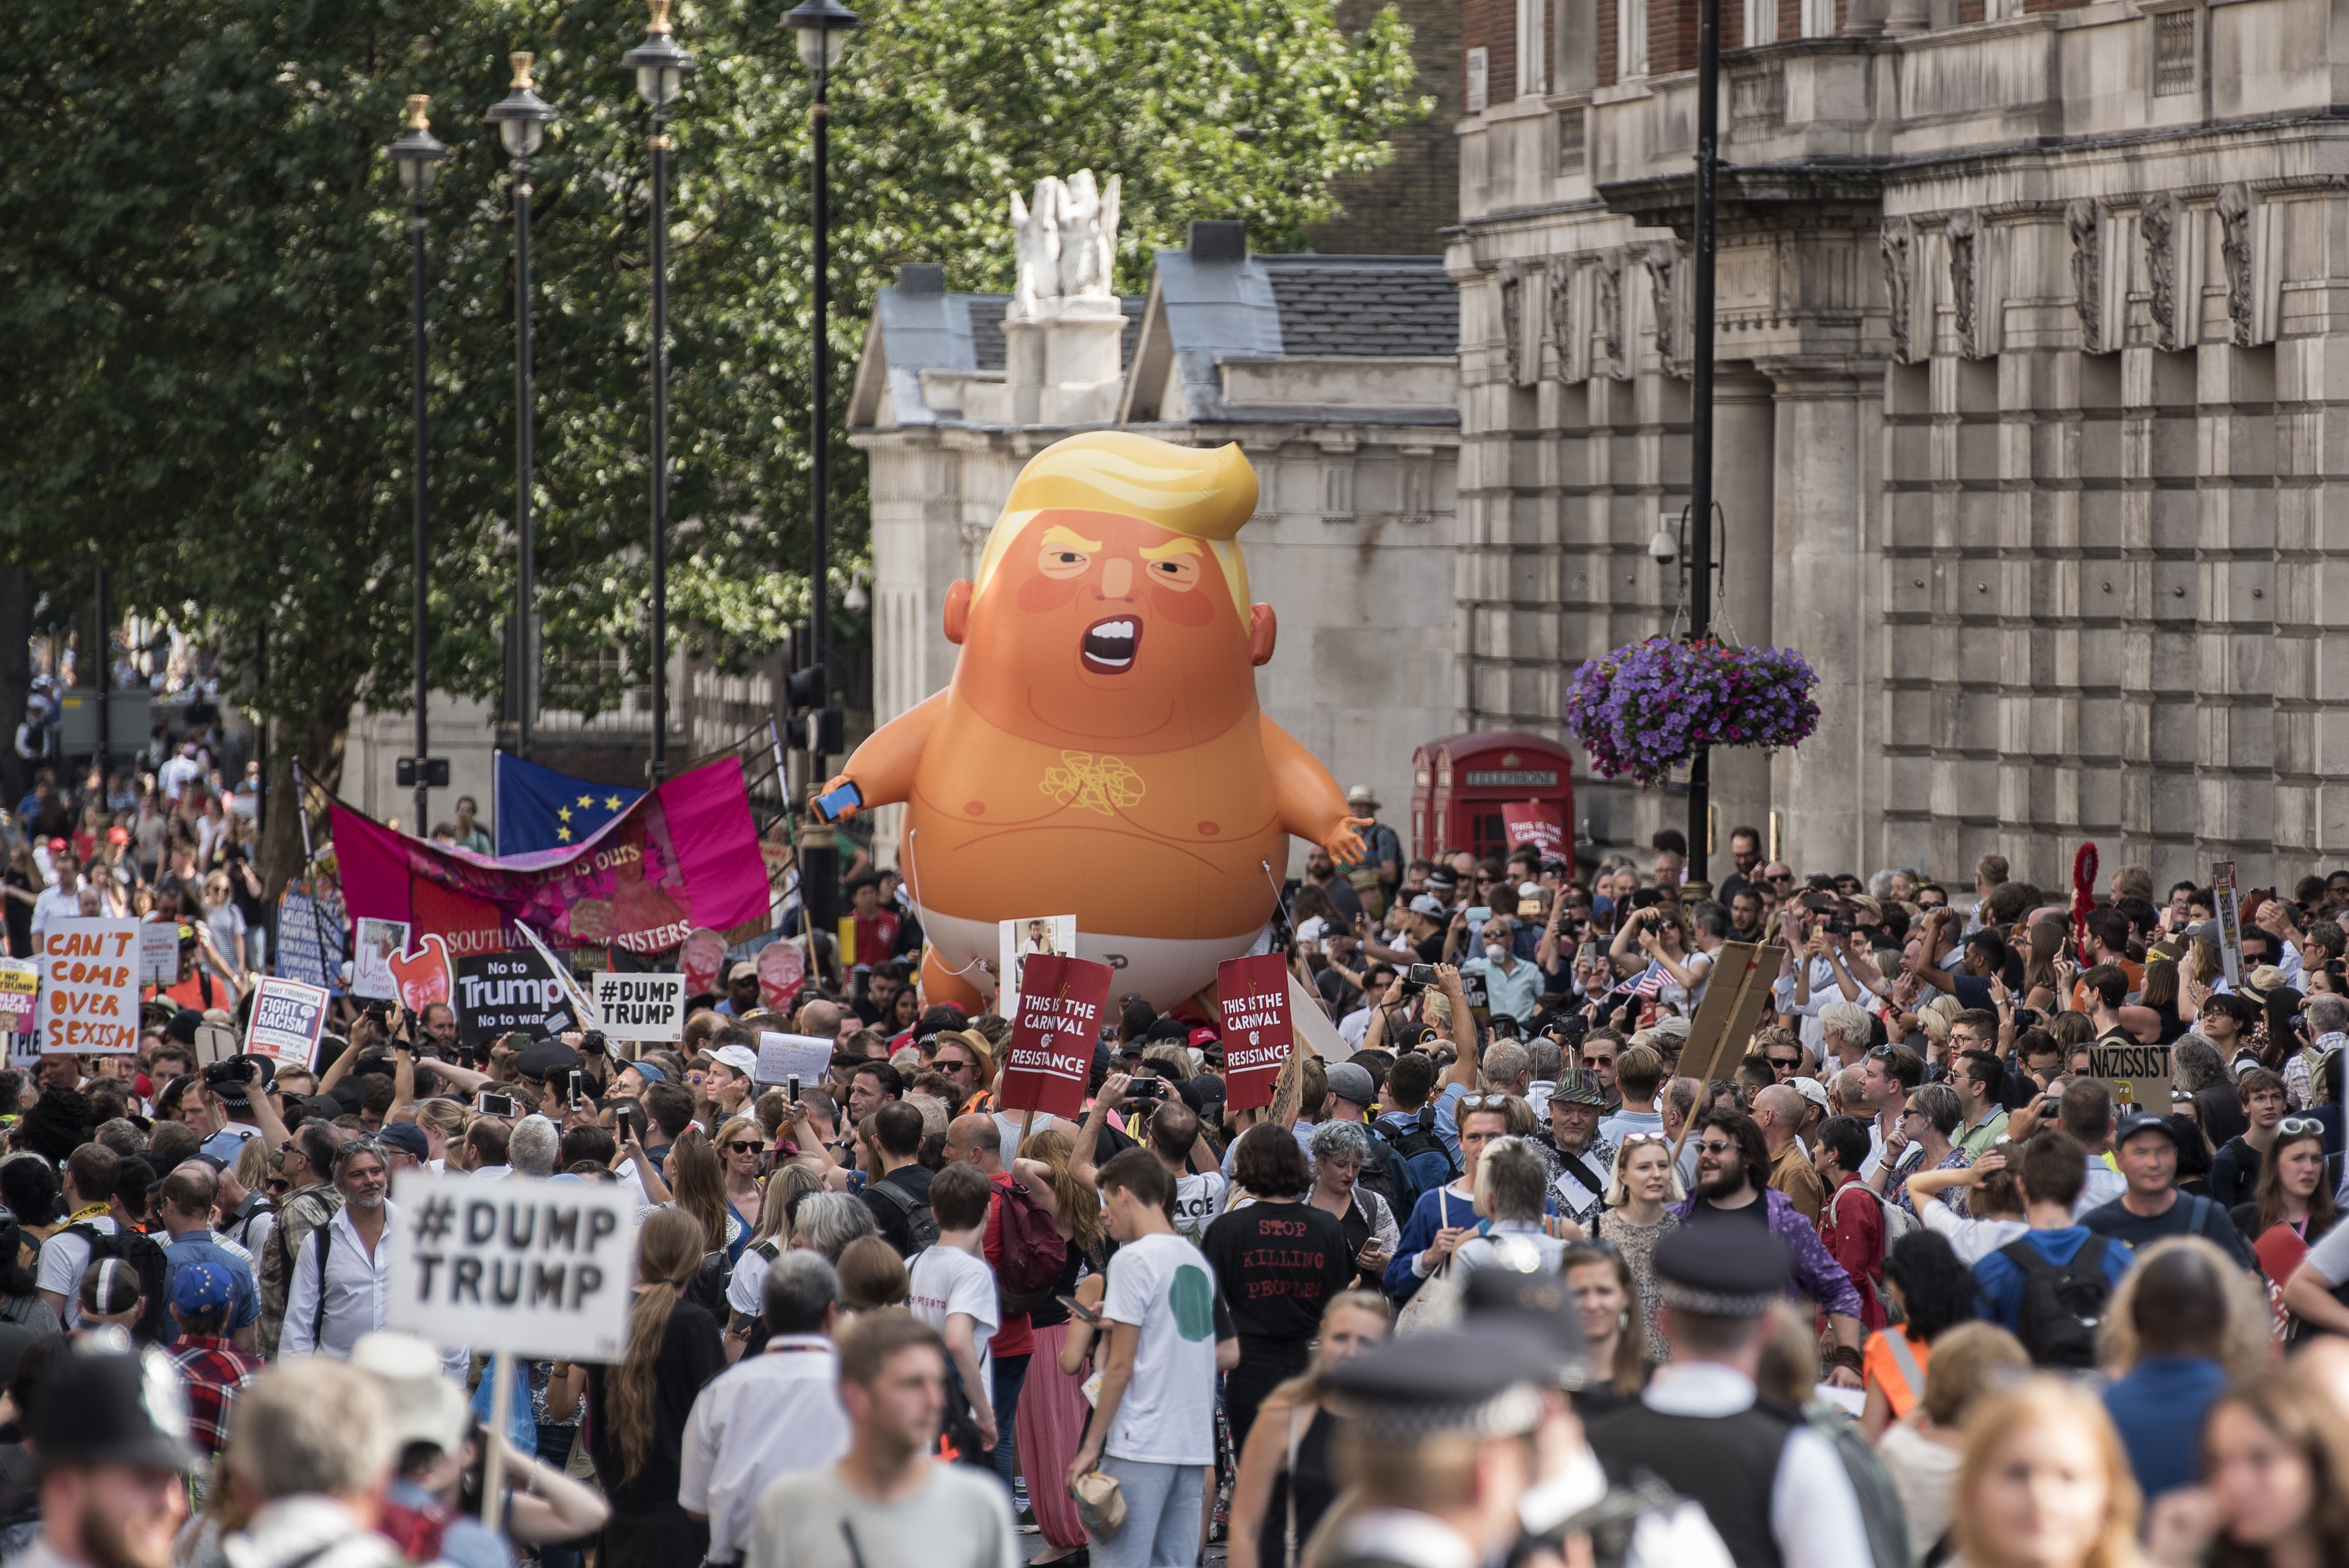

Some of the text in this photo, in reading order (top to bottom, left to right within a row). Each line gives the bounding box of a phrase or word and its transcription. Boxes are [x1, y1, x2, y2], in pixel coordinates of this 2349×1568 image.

[1470, 772, 1553, 784] TELEPHONE
[1510, 821, 1562, 835] THIS IS THE
[1515, 830, 1561, 845] CARNIVAL
[1534, 838, 1549, 848] OF
[46, 932, 133, 957] CAN'T
[617, 918, 692, 953] SISTERS
[51, 960, 129, 987] COMB
[488, 962, 528, 975] No to
[264, 985, 317, 1003] FIGHT TRUMPISM
[459, 975, 564, 1012] Trump
[599, 981, 678, 1002] #DUMP
[50, 990, 118, 1016] OVER
[260, 997, 299, 1016] FIGHT
[1025, 995, 1096, 1020] THIS IS THE
[1222, 992, 1283, 1014] THIS IS THE
[257, 1012, 308, 1034] RACISM
[478, 1013, 546, 1028] No to war
[601, 1004, 674, 1025] TRUMP
[1024, 1014, 1084, 1036] CARNIVAL
[1227, 1010, 1281, 1031] CARNIVAL
[48, 1019, 135, 1048] SEXISM
[289, 1034, 306, 1044] homes
[1041, 1033, 1054, 1048] OF
[1249, 1031, 1260, 1046] OF
[1011, 1049, 1085, 1074] RESISTANCE
[1227, 1044, 1290, 1067] RESISTANCE
[2090, 1047, 2171, 1078] NAZISSIST
[411, 1195, 617, 1253] #DUMP
[1258, 1219, 1307, 1237] STOP
[1242, 1249, 1325, 1269] KILLING
[413, 1251, 604, 1311] TRUMP
[1246, 1280, 1321, 1299] PEOPLE!
